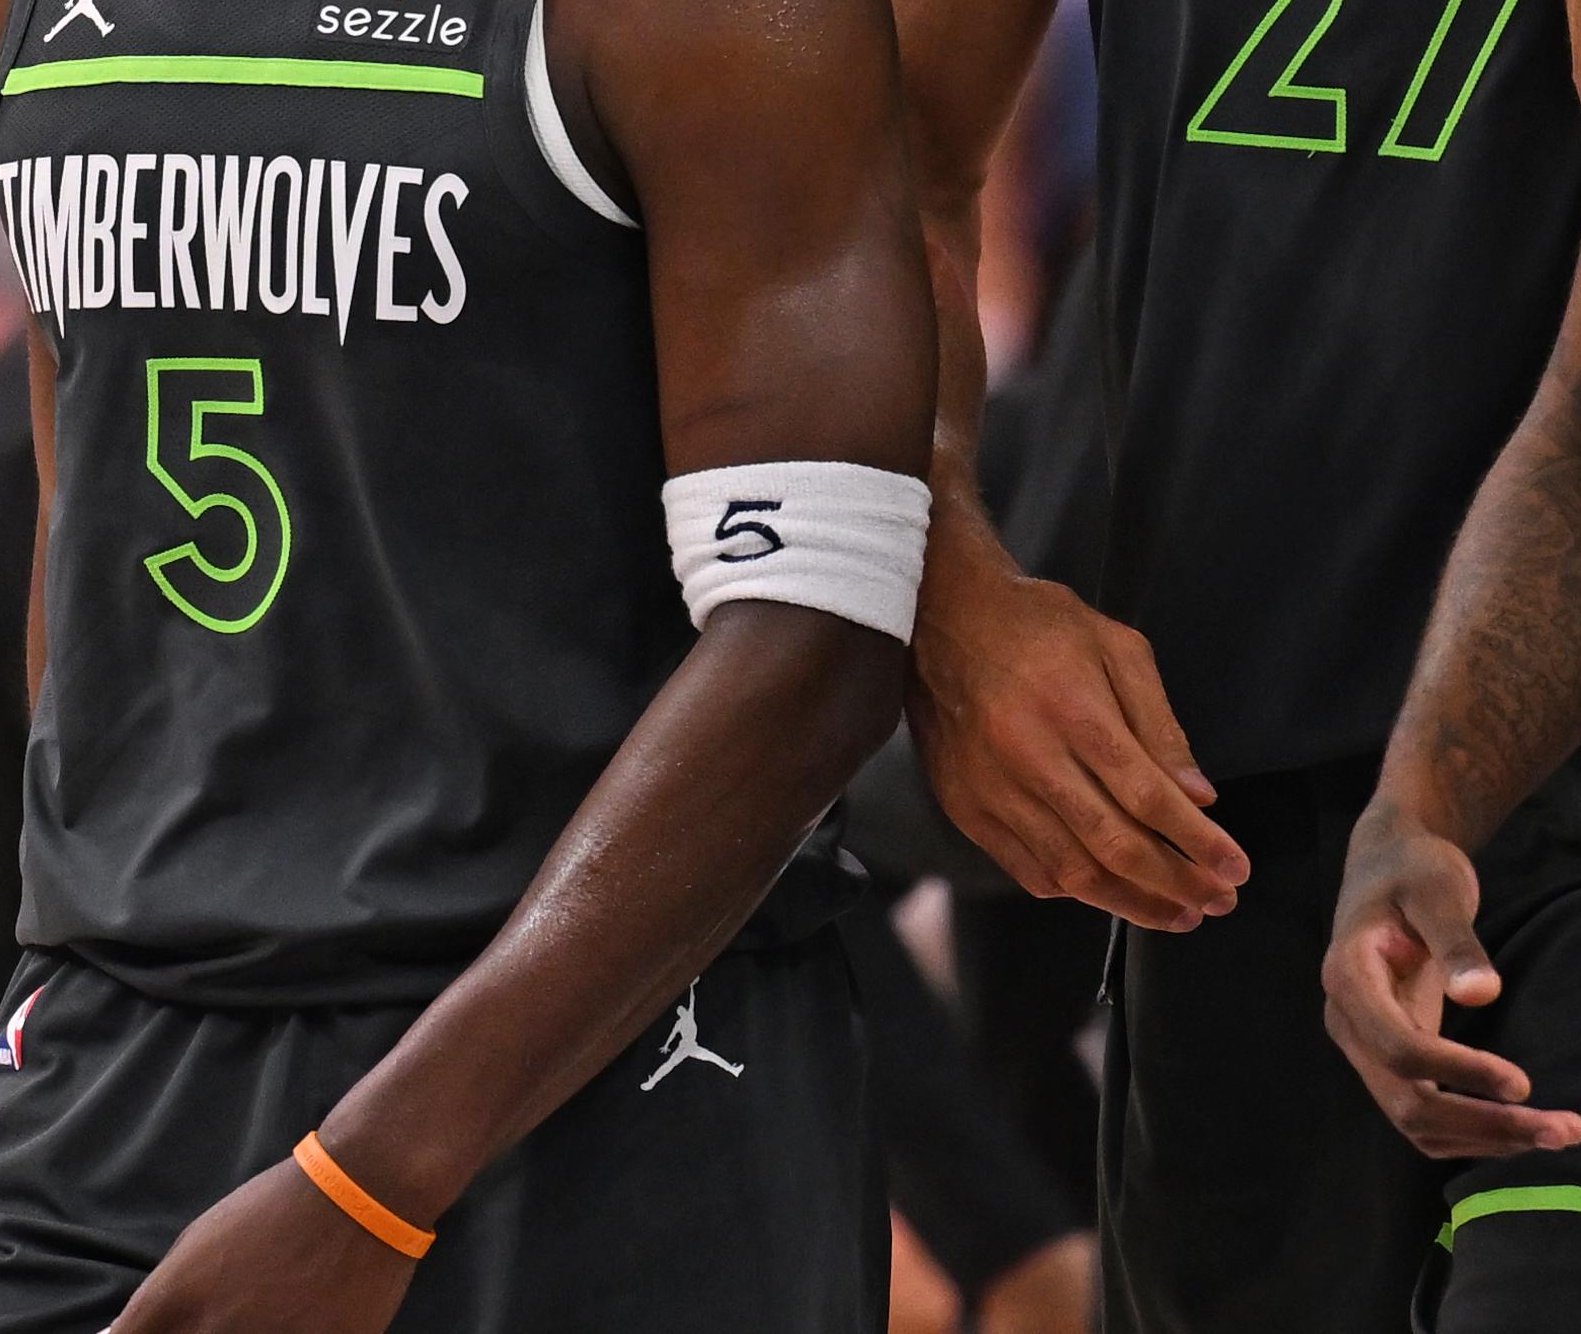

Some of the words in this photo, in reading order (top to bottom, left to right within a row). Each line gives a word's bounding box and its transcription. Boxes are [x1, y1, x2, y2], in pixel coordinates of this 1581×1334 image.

[316, 3, 467, 46] sezzle
[143, 357, 292, 634] 5
[713, 499, 787, 564] 5
